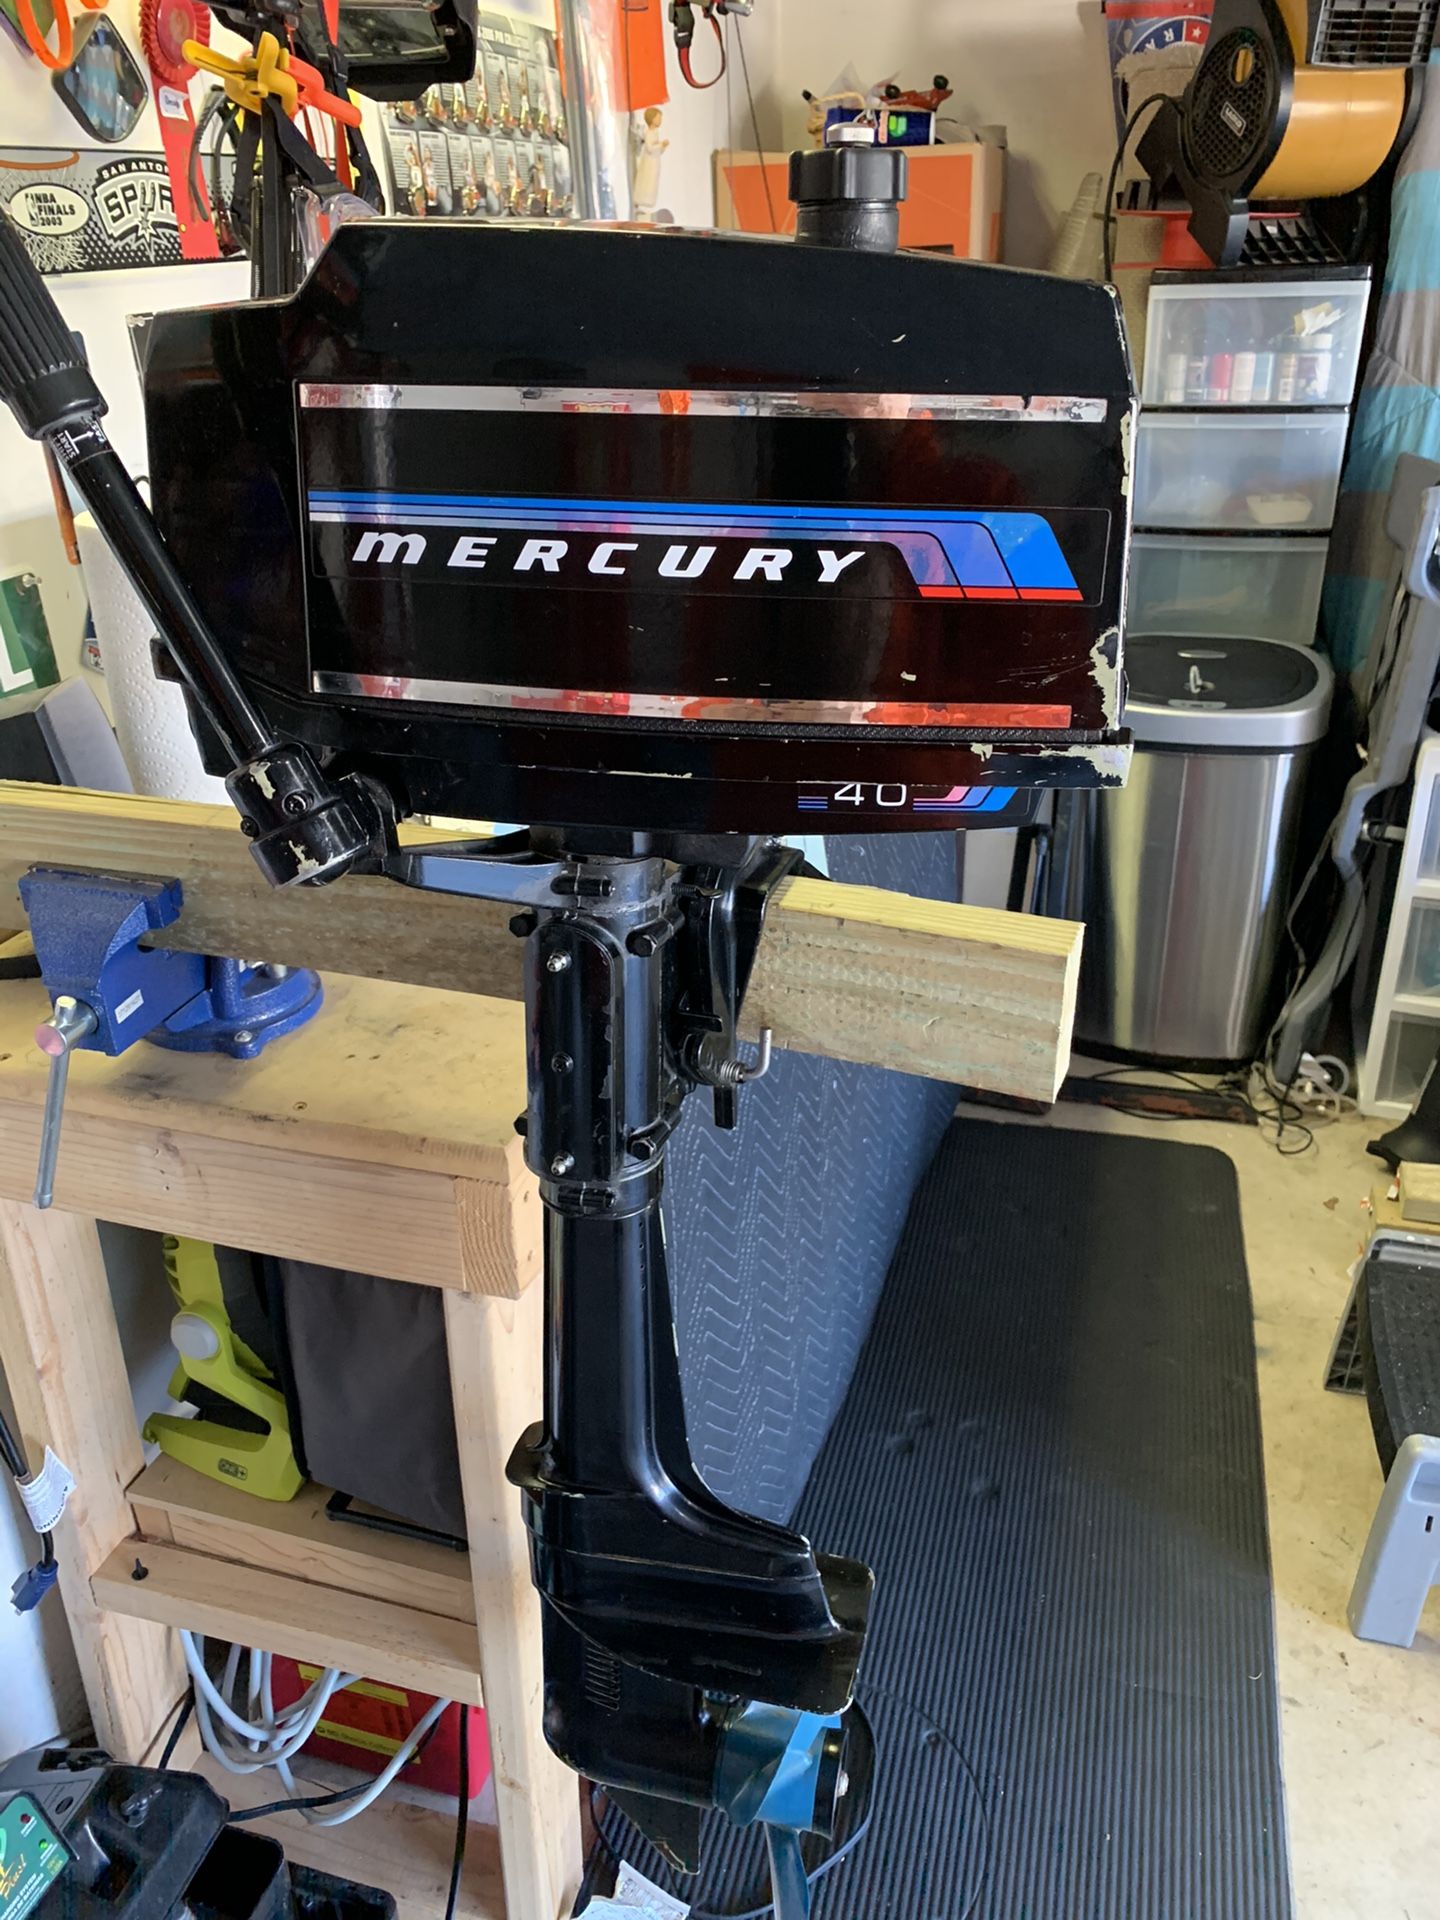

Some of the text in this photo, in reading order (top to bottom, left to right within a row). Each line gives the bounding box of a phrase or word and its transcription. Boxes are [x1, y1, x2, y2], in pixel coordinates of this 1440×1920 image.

[102, 162, 127, 180] SAN
[35, 192, 57, 204] NBA
[103, 181, 175, 224] SPUR
[37, 204, 76, 216] FINALS
[40, 216, 63, 227] 2003
[57, 432, 77, 459] START
[351, 531, 866, 583] MERCURY
[834, 783, 907, 807] 40
